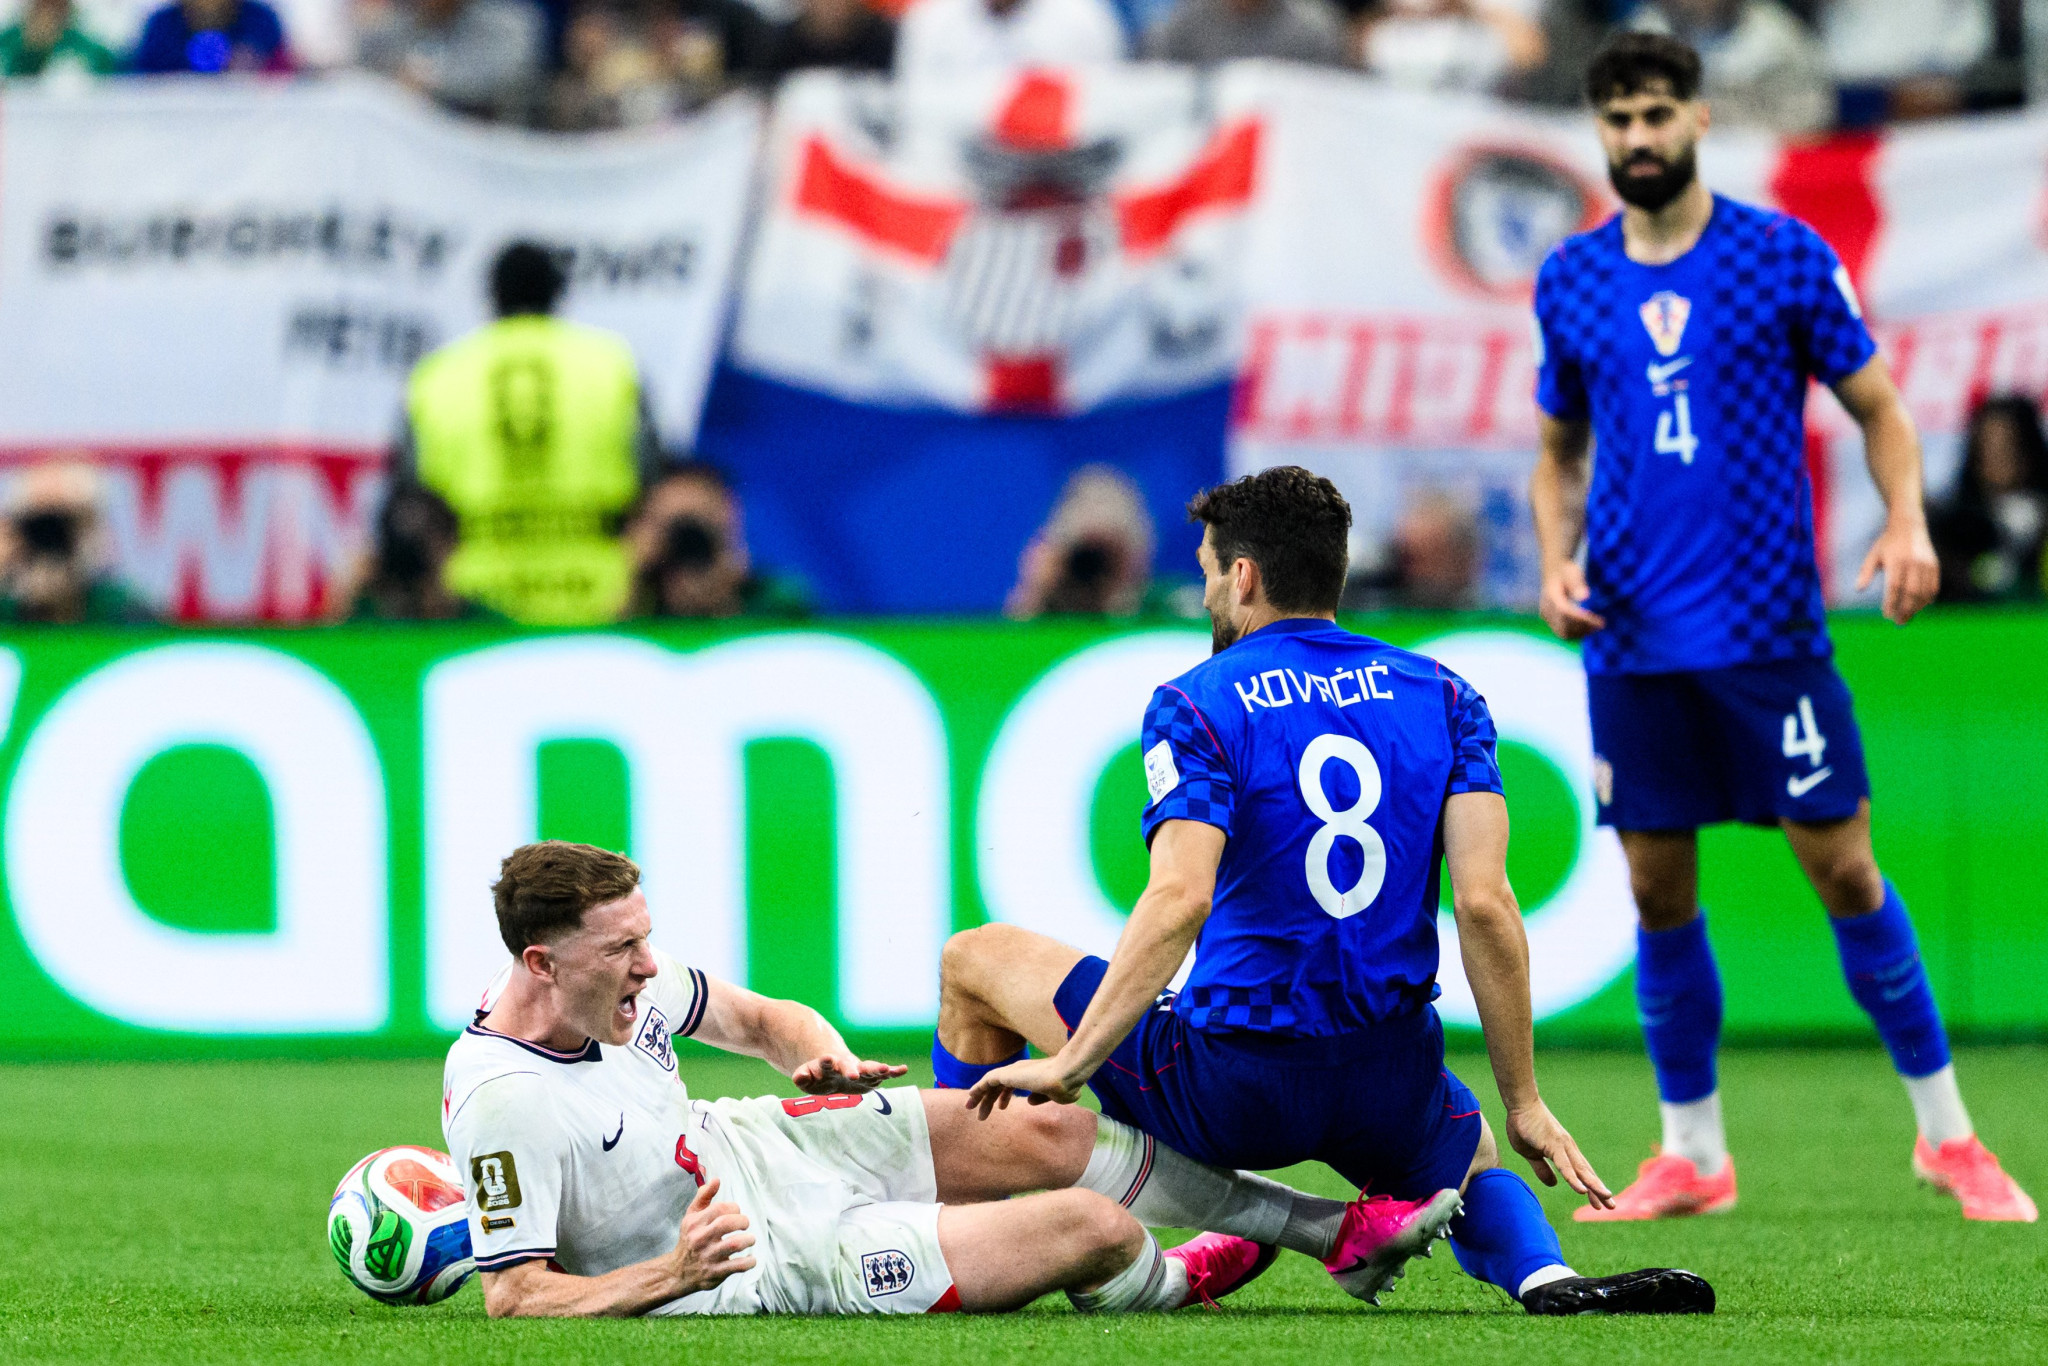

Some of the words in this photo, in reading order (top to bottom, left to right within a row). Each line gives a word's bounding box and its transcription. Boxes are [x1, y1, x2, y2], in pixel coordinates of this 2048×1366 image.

[1655, 392, 1699, 465] 4
[1782, 695, 1827, 768] 4
[1299, 734, 1386, 919] 8
